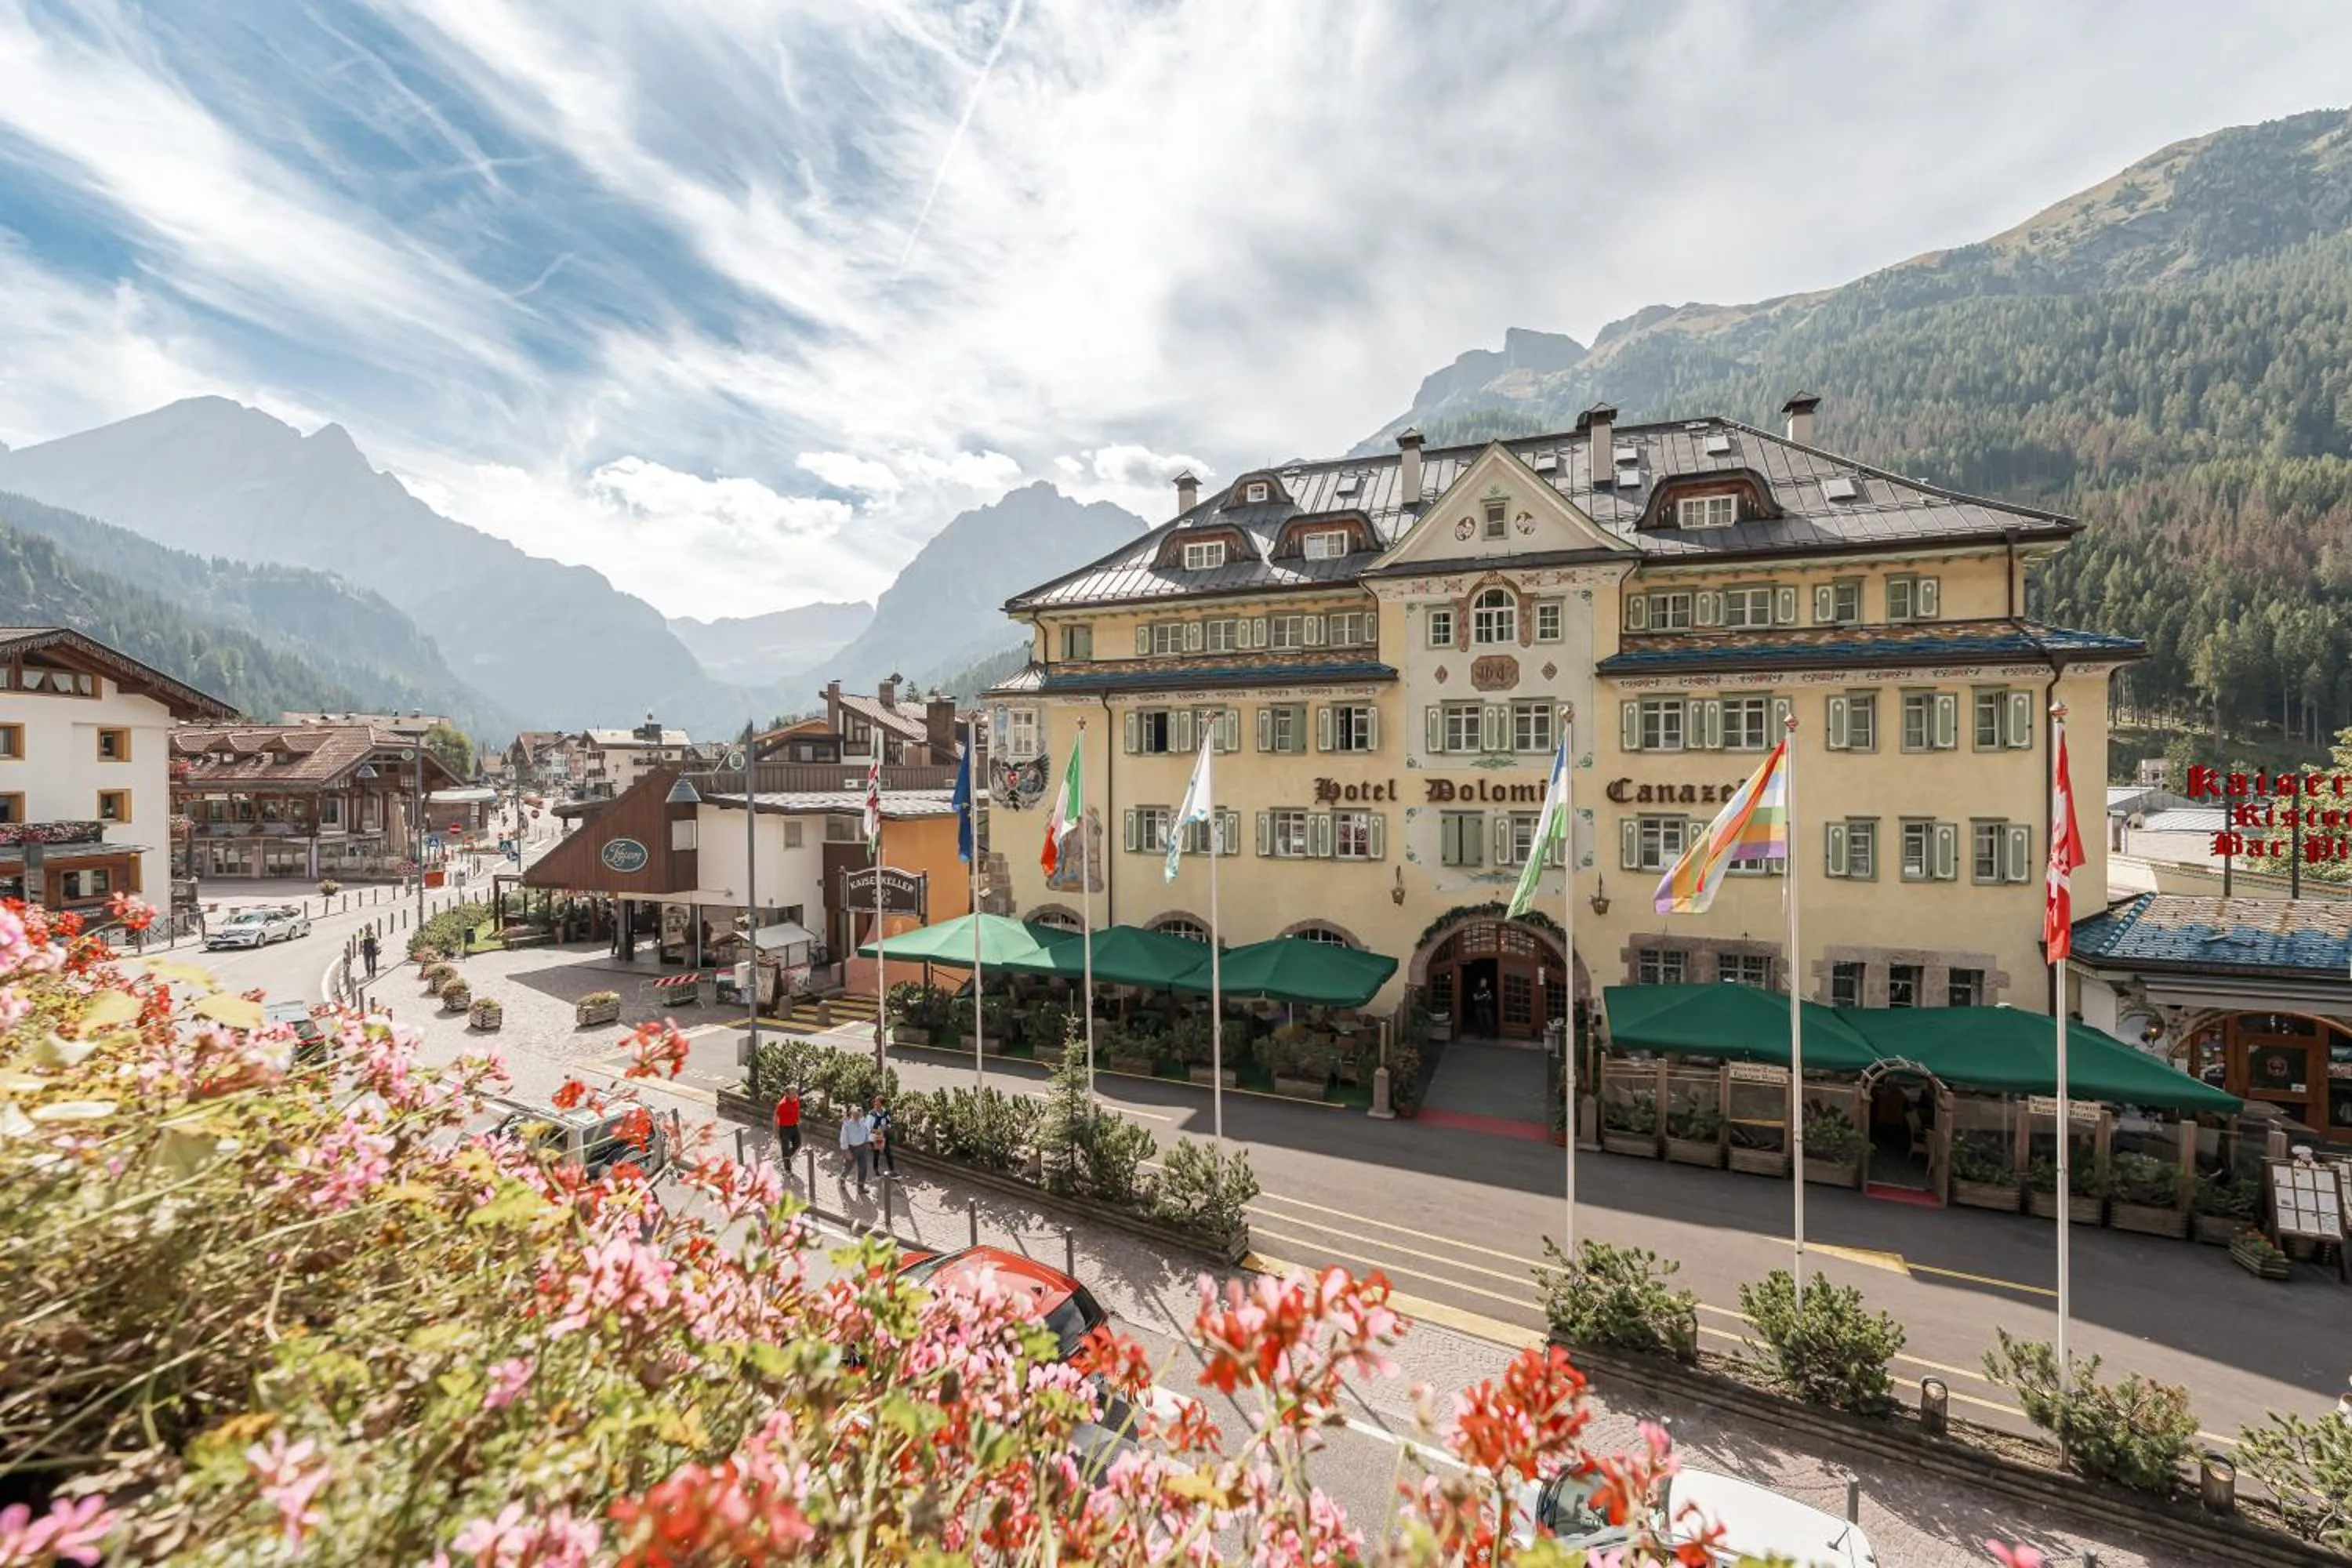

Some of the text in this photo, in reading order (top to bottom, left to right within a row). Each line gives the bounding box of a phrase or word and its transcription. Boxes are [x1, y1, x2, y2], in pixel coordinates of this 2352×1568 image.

[1314, 777, 1398, 805] Hotel
[1425, 779, 1550, 802] Dolomi
[2210, 829, 2292, 858] Bar
[849, 875, 915, 895] KAISEKELLER
